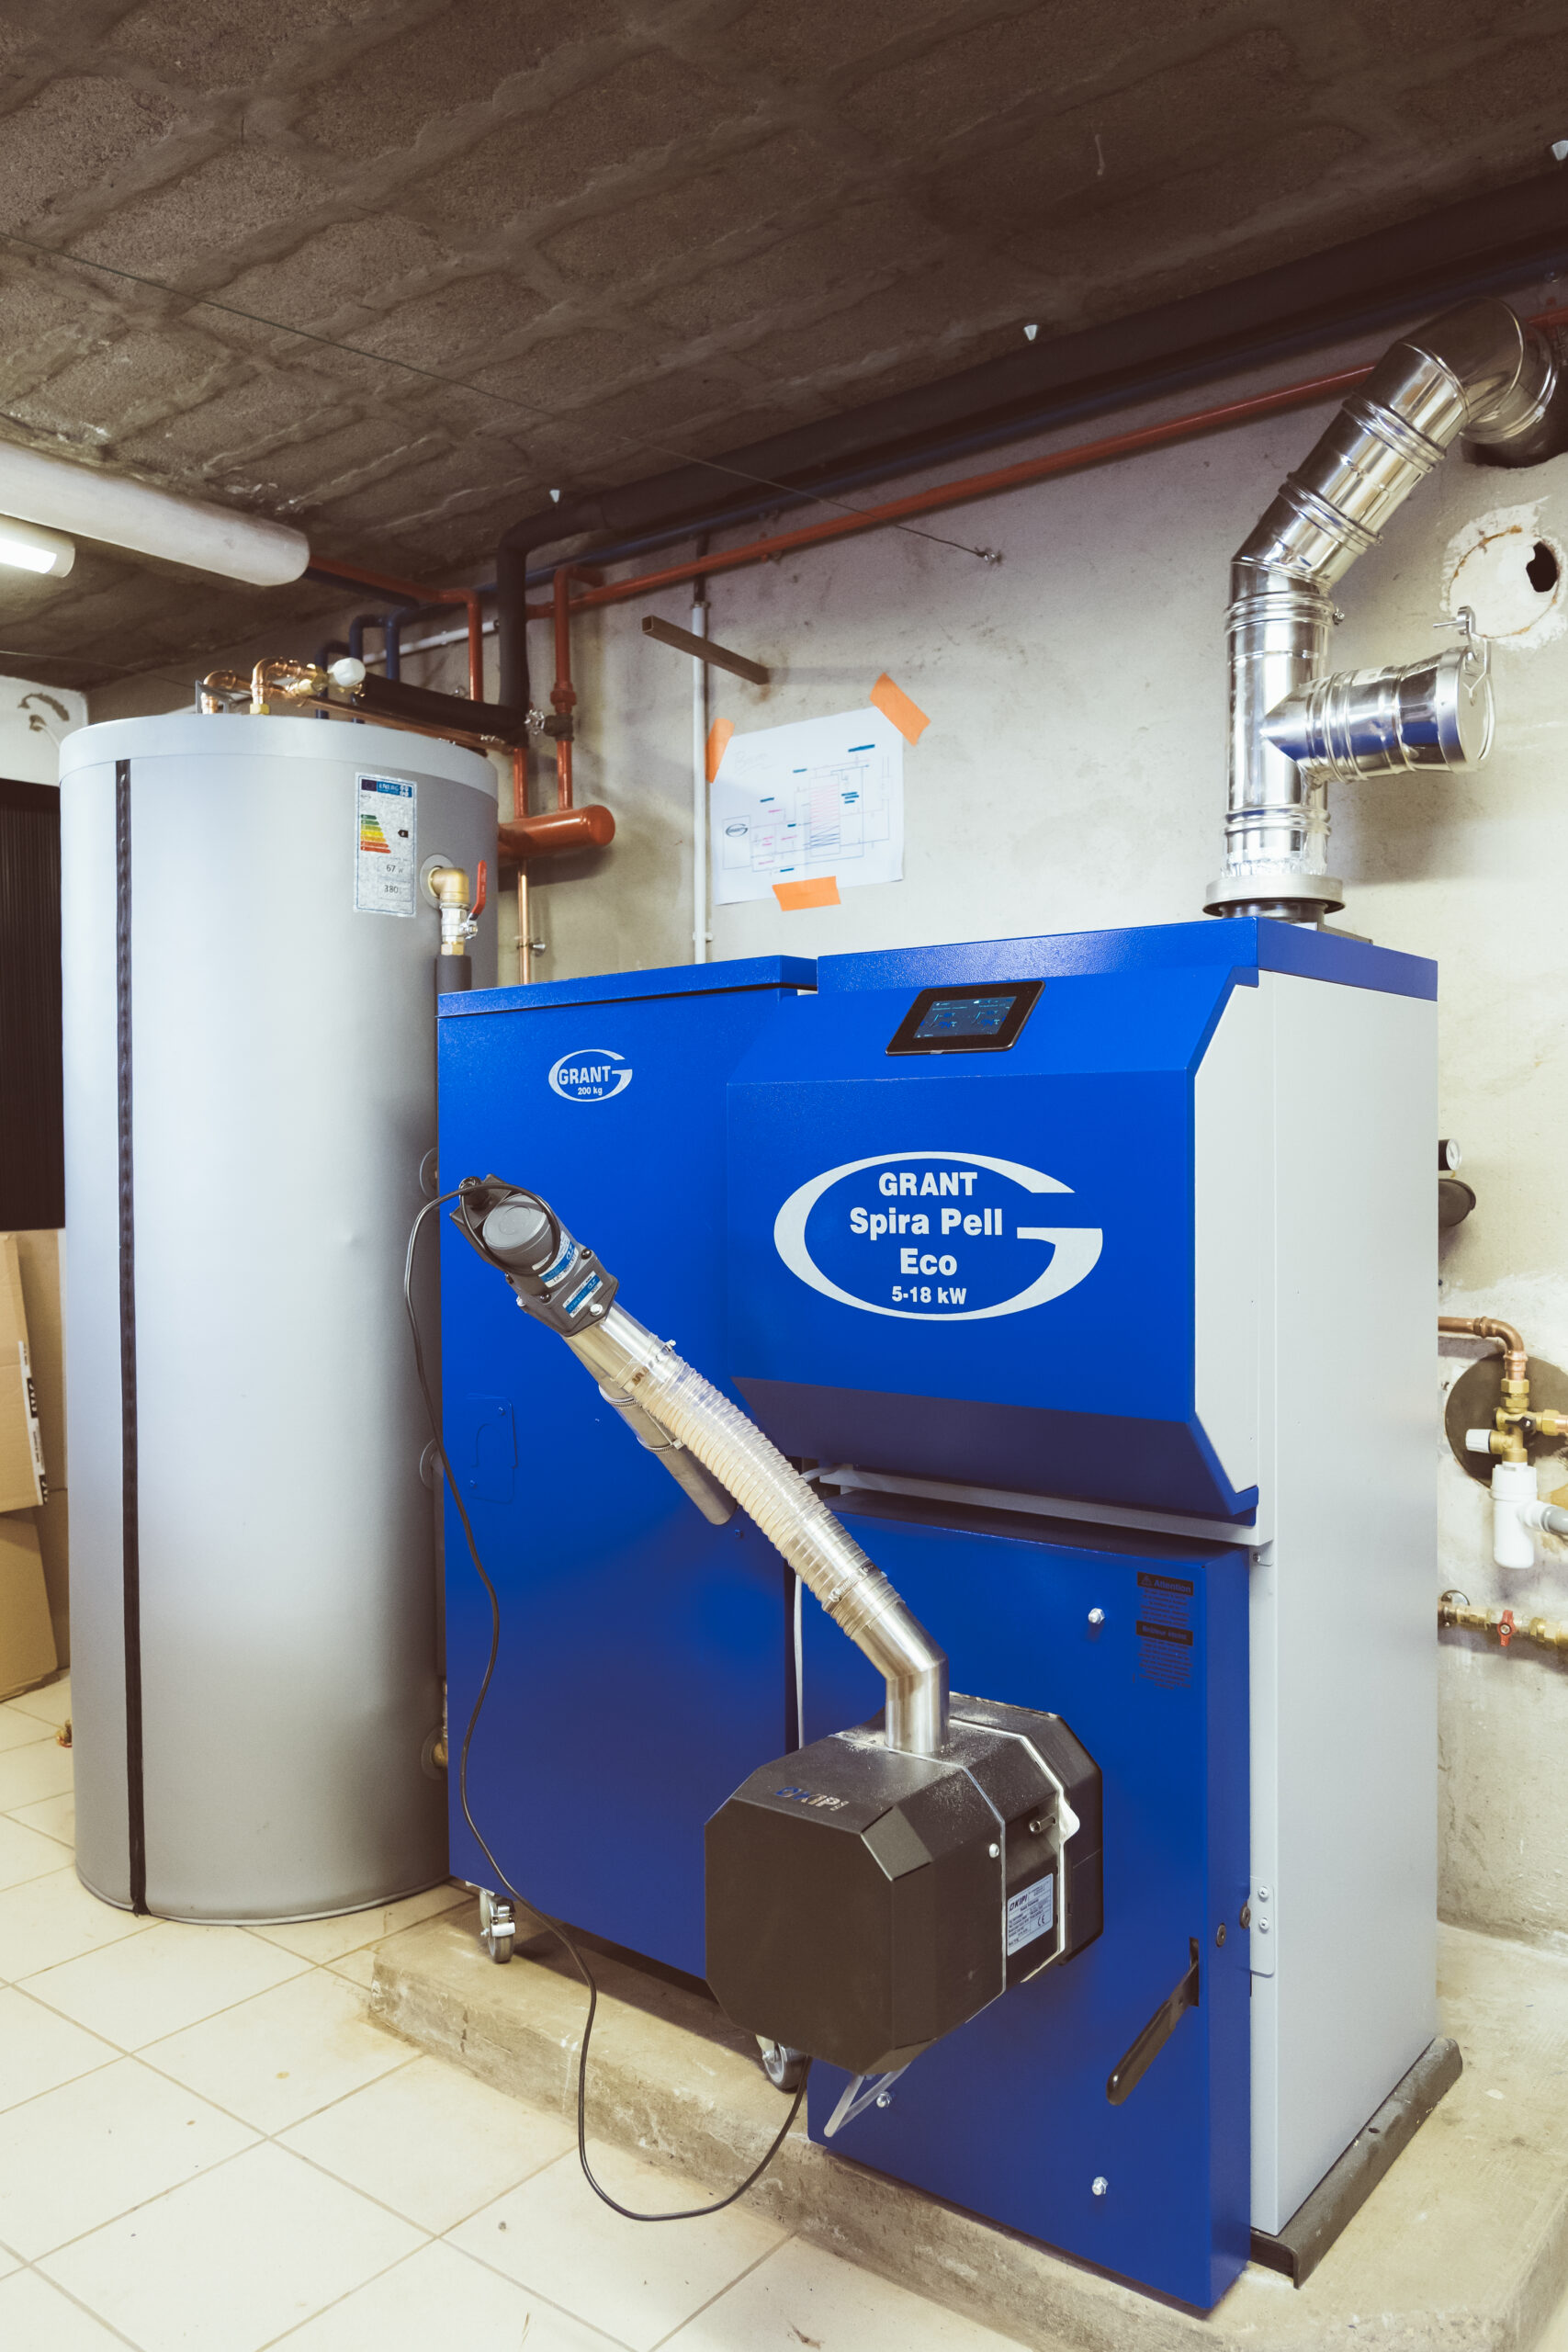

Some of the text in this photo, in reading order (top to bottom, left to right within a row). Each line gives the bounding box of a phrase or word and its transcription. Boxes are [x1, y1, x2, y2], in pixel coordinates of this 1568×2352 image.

[386, 865, 396, 873] 67
[558, 1066, 611, 1085] GRANT
[578, 1086, 603, 1096] 200 kg
[878, 1171, 978, 1197] GRANT
[850, 1207, 1003, 1241] Spira Pell
[899, 1248, 958, 1276] Eco
[891, 1285, 967, 1305] 5-18 kW
